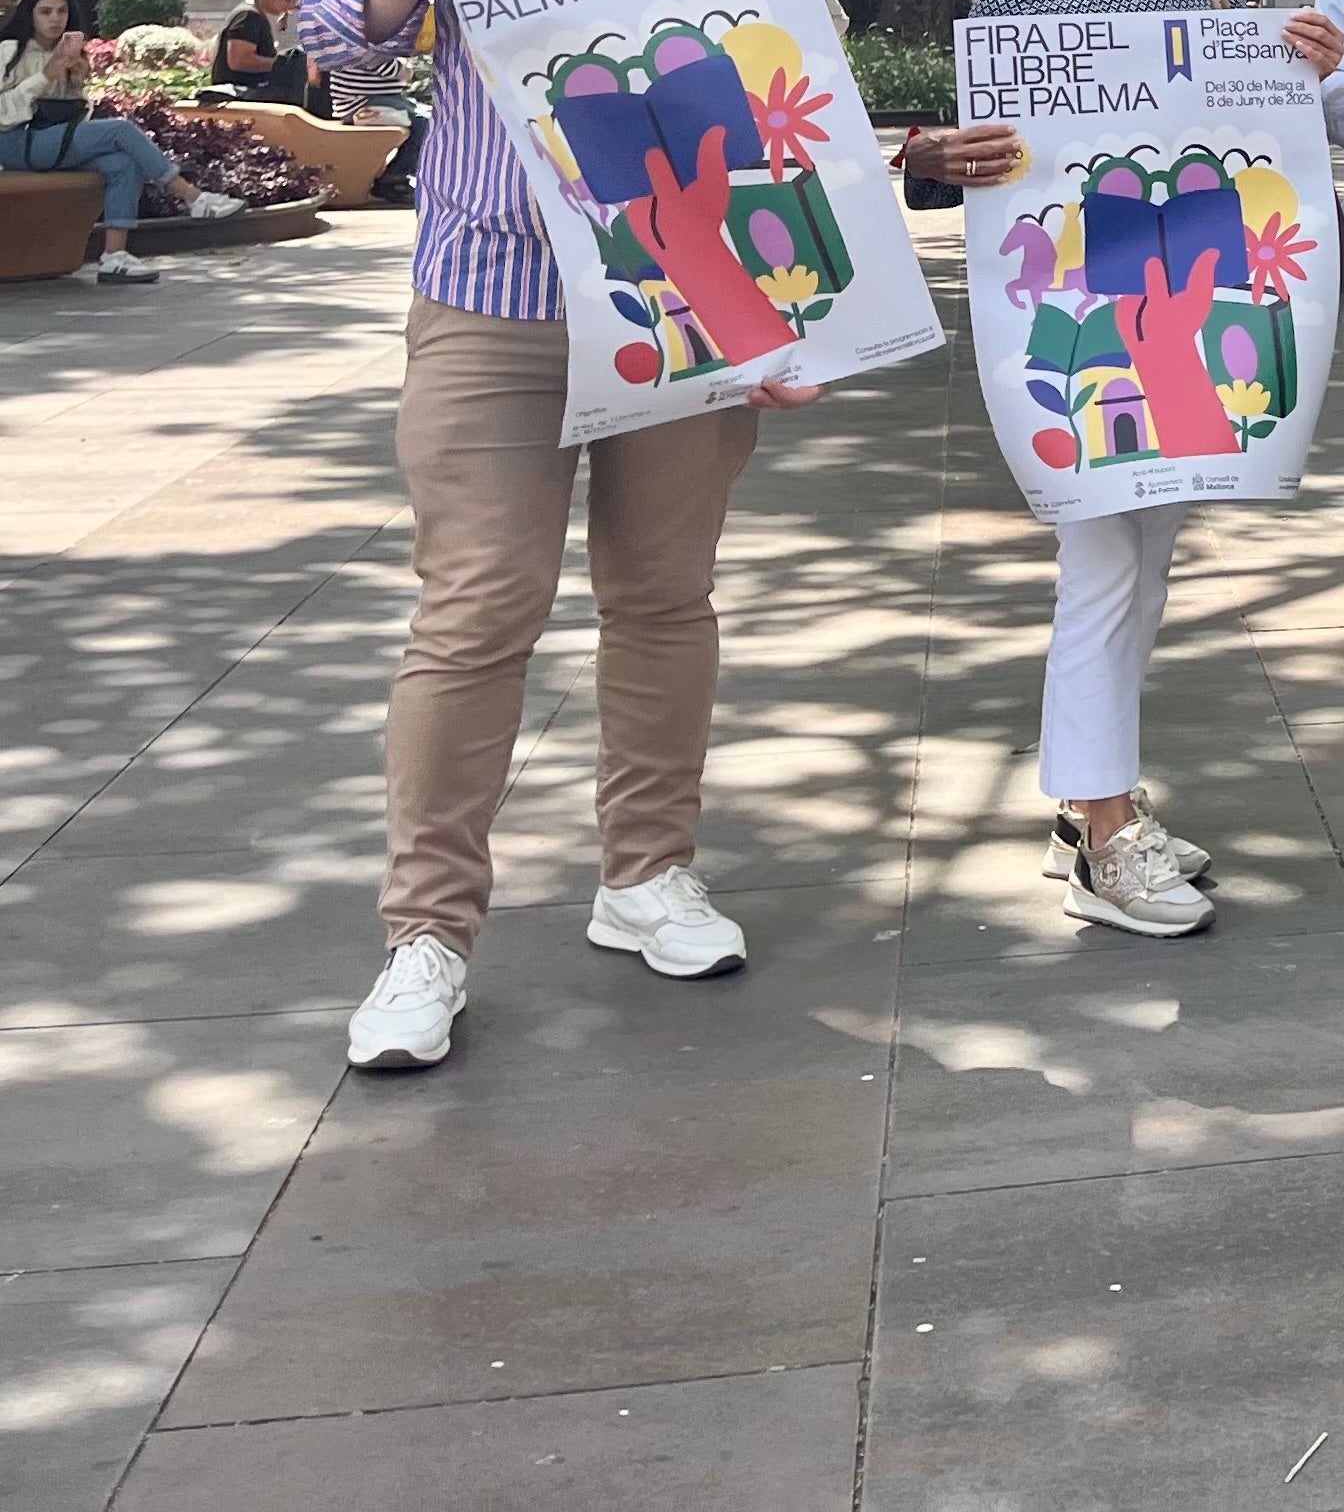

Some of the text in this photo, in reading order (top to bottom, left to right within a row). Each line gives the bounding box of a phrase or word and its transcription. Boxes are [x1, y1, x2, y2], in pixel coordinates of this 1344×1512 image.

[965, 21, 1130, 57] FIRA DEL
[1200, 18, 1259, 41] Plaça
[967, 53, 1096, 88] LLIBRE
[969, 81, 1160, 121] DE PALMA
[1205, 79, 1306, 94] Del 30 de Maig al
[1206, 93, 1315, 108] 8 de Juny de 2025
